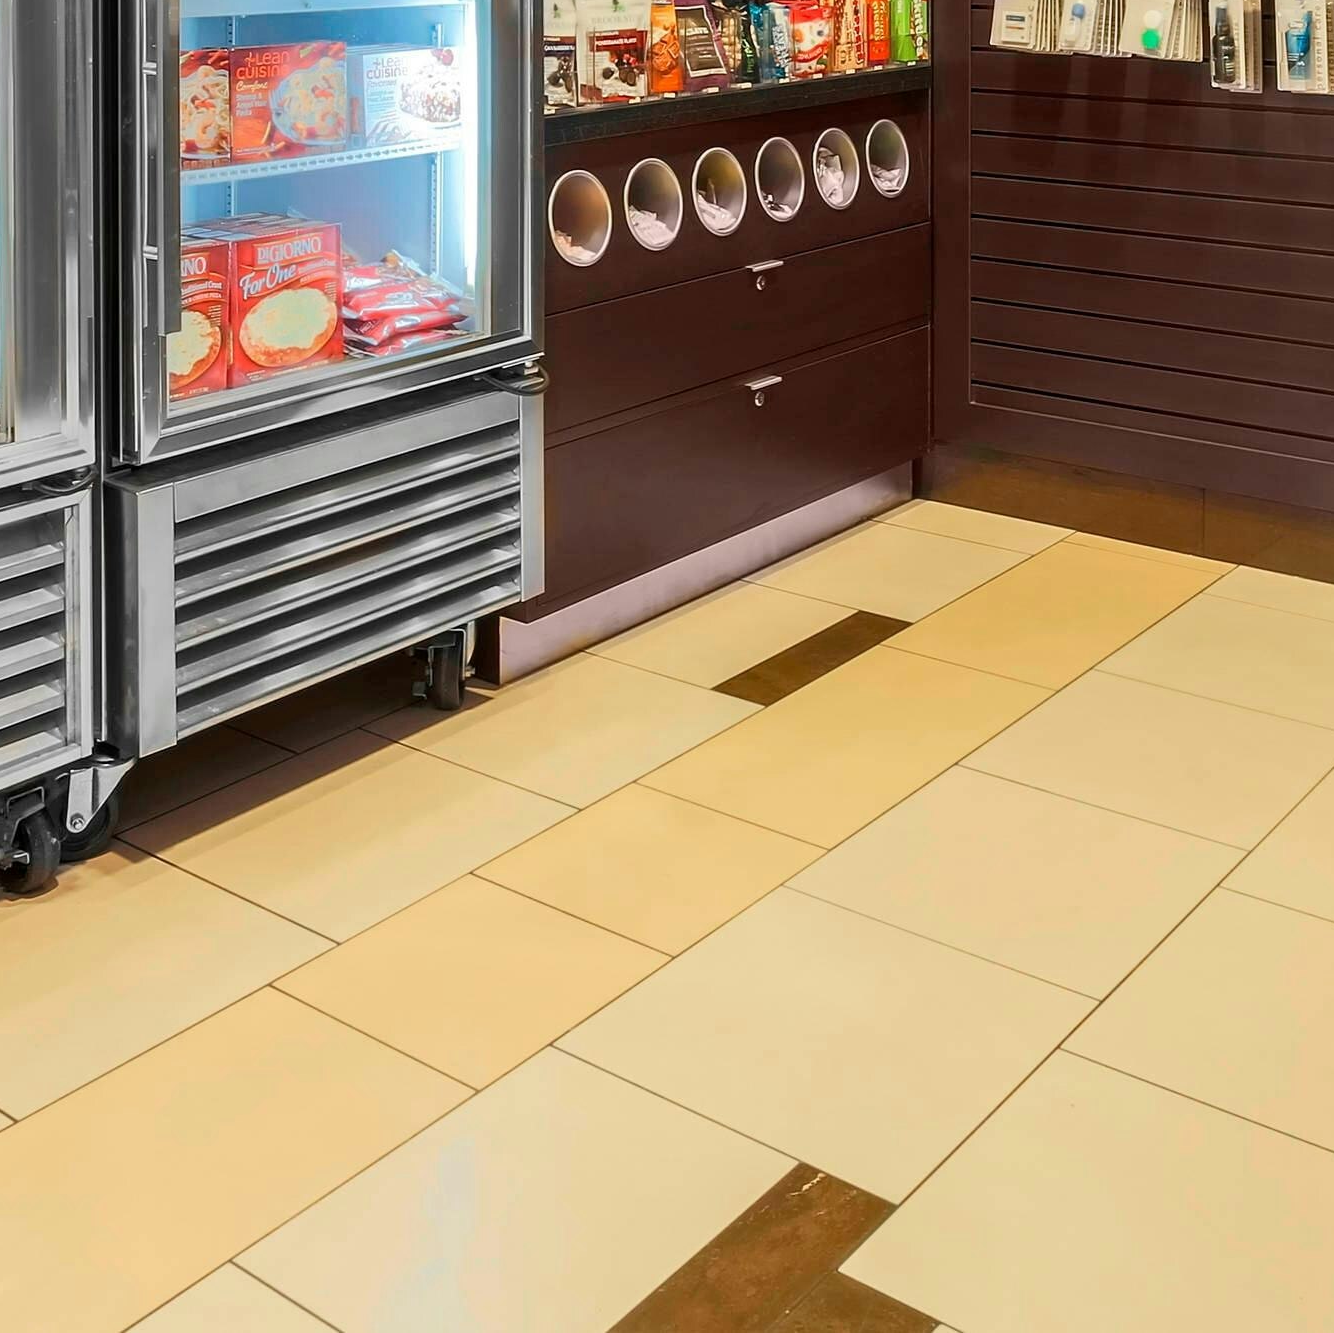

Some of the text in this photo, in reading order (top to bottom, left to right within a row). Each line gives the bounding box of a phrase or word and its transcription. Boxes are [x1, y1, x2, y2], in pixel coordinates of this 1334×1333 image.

[235, 80, 268, 92] Comfort
[208, 281, 222, 290] Crust
[239, 263, 298, 300] For One
